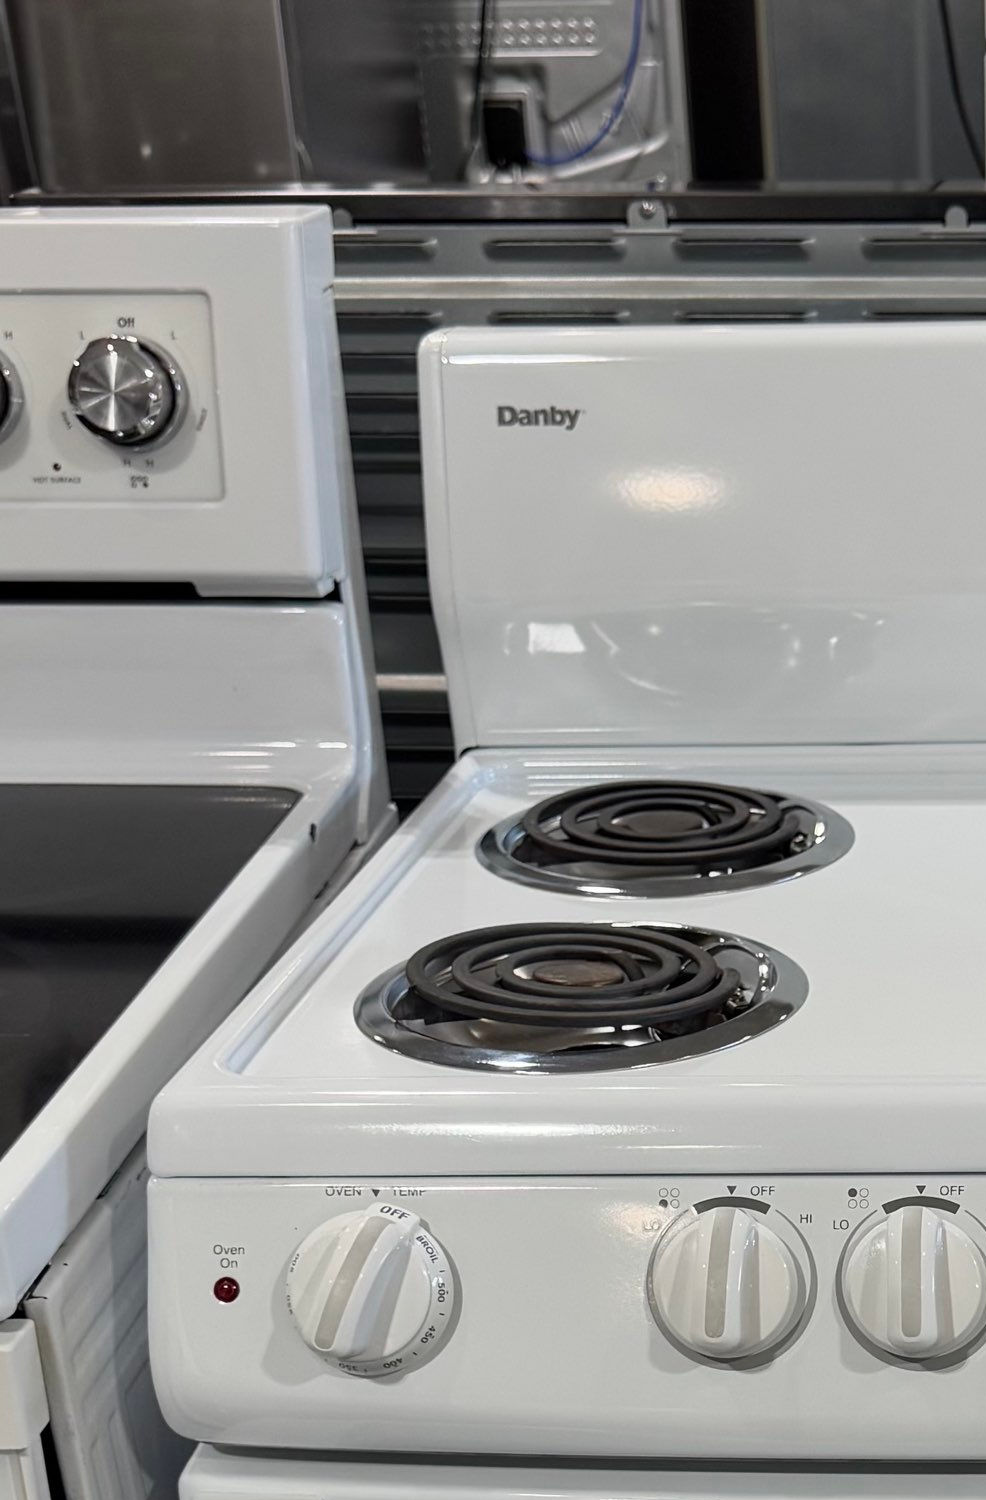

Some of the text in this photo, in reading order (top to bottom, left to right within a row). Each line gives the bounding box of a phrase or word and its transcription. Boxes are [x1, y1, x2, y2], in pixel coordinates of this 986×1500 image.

[117, 317, 135, 328] Off
[497, 405, 580, 432] Danby
[325, 1186, 362, 1197] OVEN
[750, 1185, 776, 1197] OFF
[939, 1185, 965, 1197] OFF
[380, 1205, 411, 1220] OFF
[799, 1213, 813, 1224] HI
[833, 1219, 850, 1231] LO
[213, 1244, 245, 1255] Oven
[416, 1235, 439, 1264] BROIL
[220, 1257, 238, 1268] On
[437, 1282, 447, 1303] 500
[420, 1325, 436, 1344] 450
